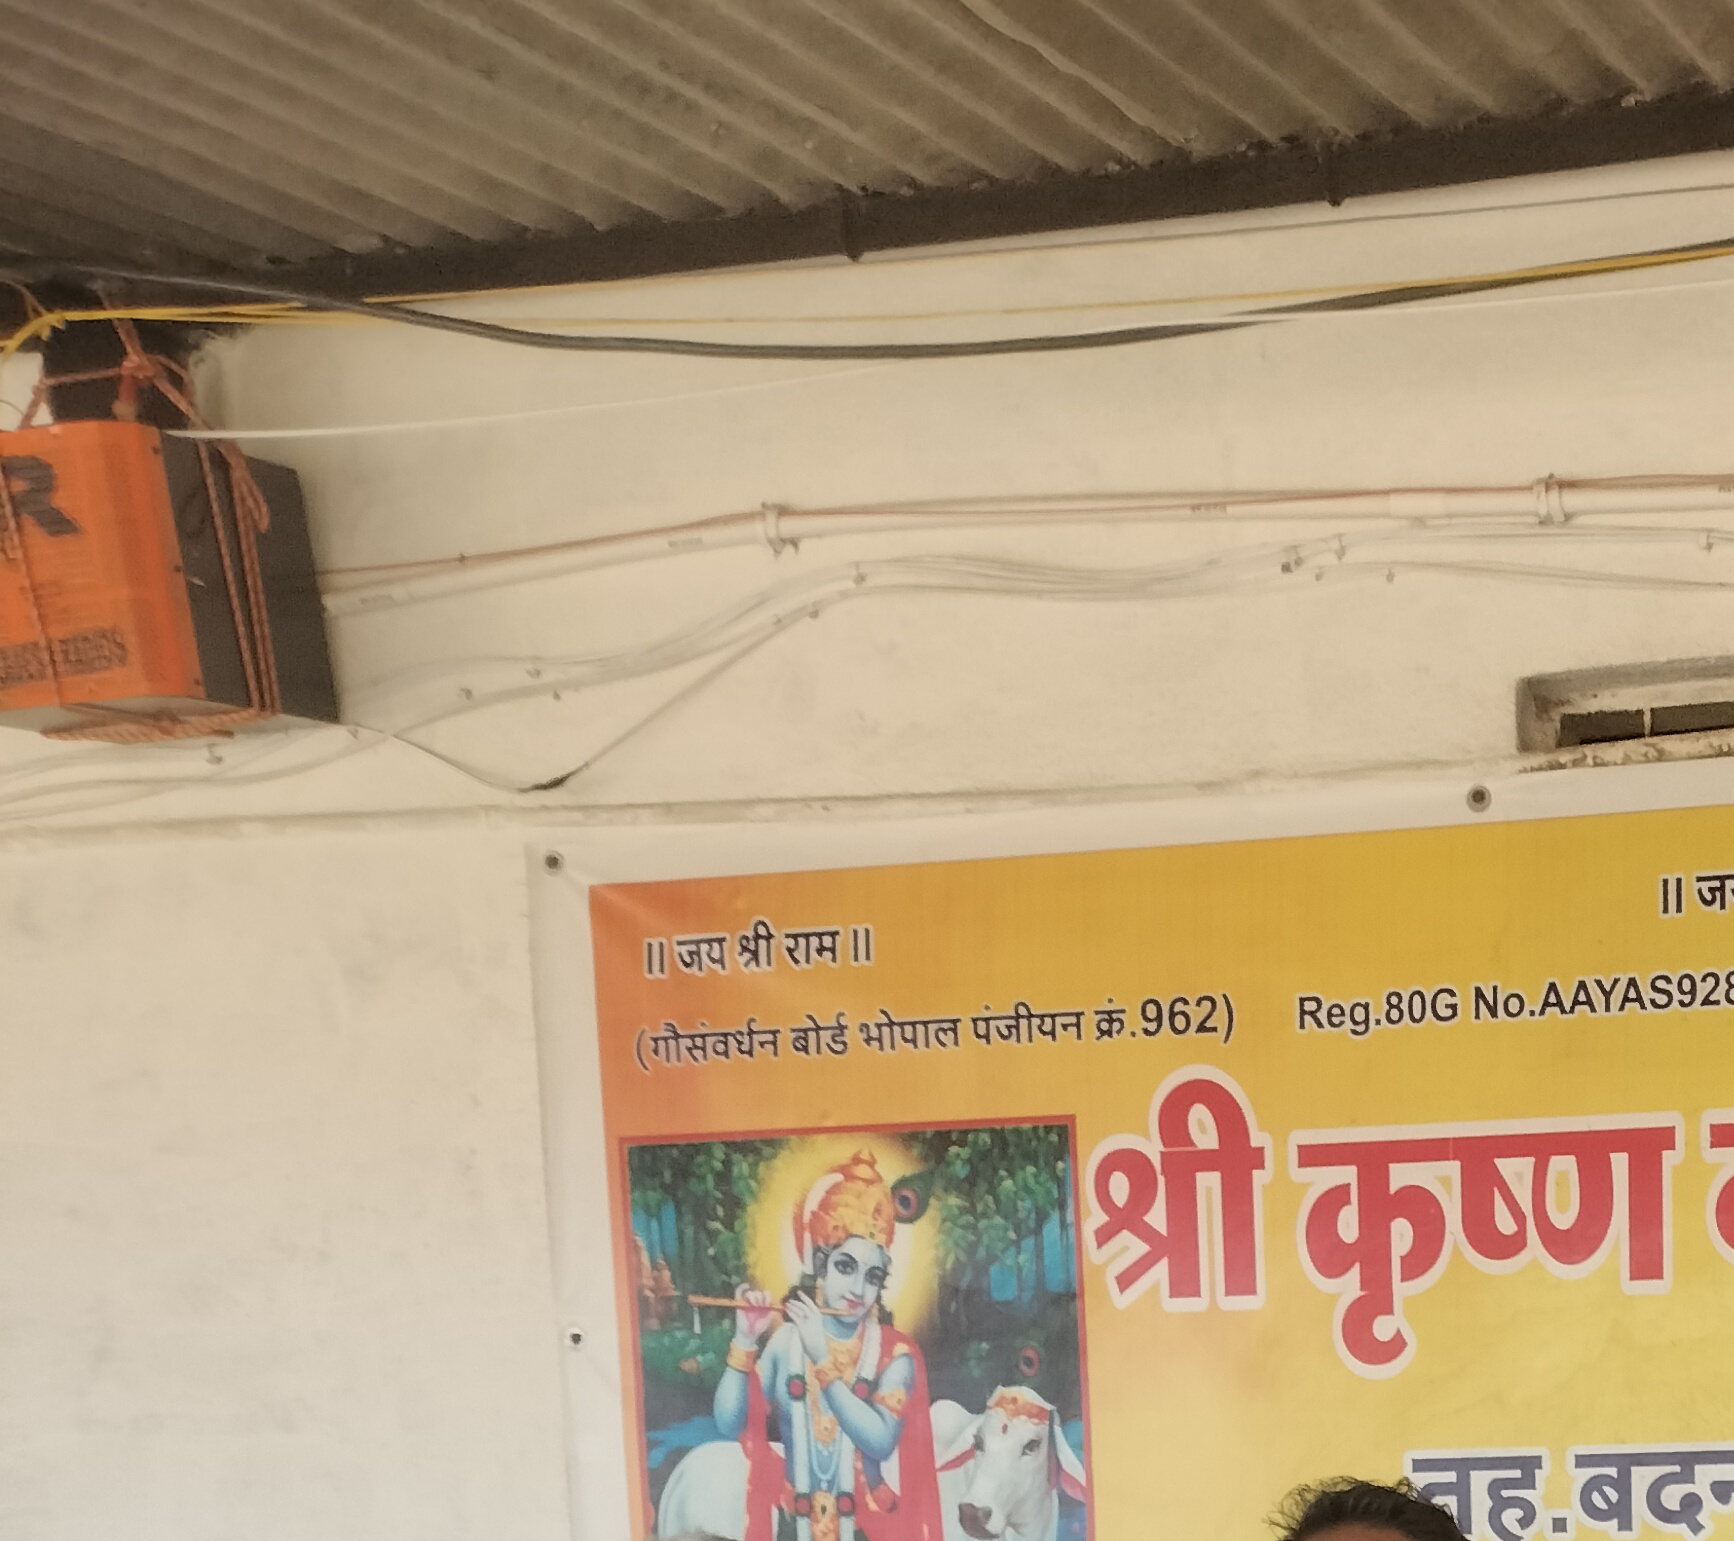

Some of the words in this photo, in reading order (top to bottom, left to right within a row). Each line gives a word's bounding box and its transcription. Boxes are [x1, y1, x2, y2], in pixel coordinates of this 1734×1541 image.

[679, 936, 726, 974] जय
[740, 920, 774, 970] श्री
[785, 928, 837, 965] राम
[791, 1014, 848, 1055] बोर्ड
[860, 1009, 960, 1051] भोपाल
[973, 1003, 1083, 1046] पंजीयन
[1298, 989, 1459, 1035] Reg.80G
[1094, 1078, 1265, 1304] श्री
[1297, 1126, 1676, 1366] कृष्ण
